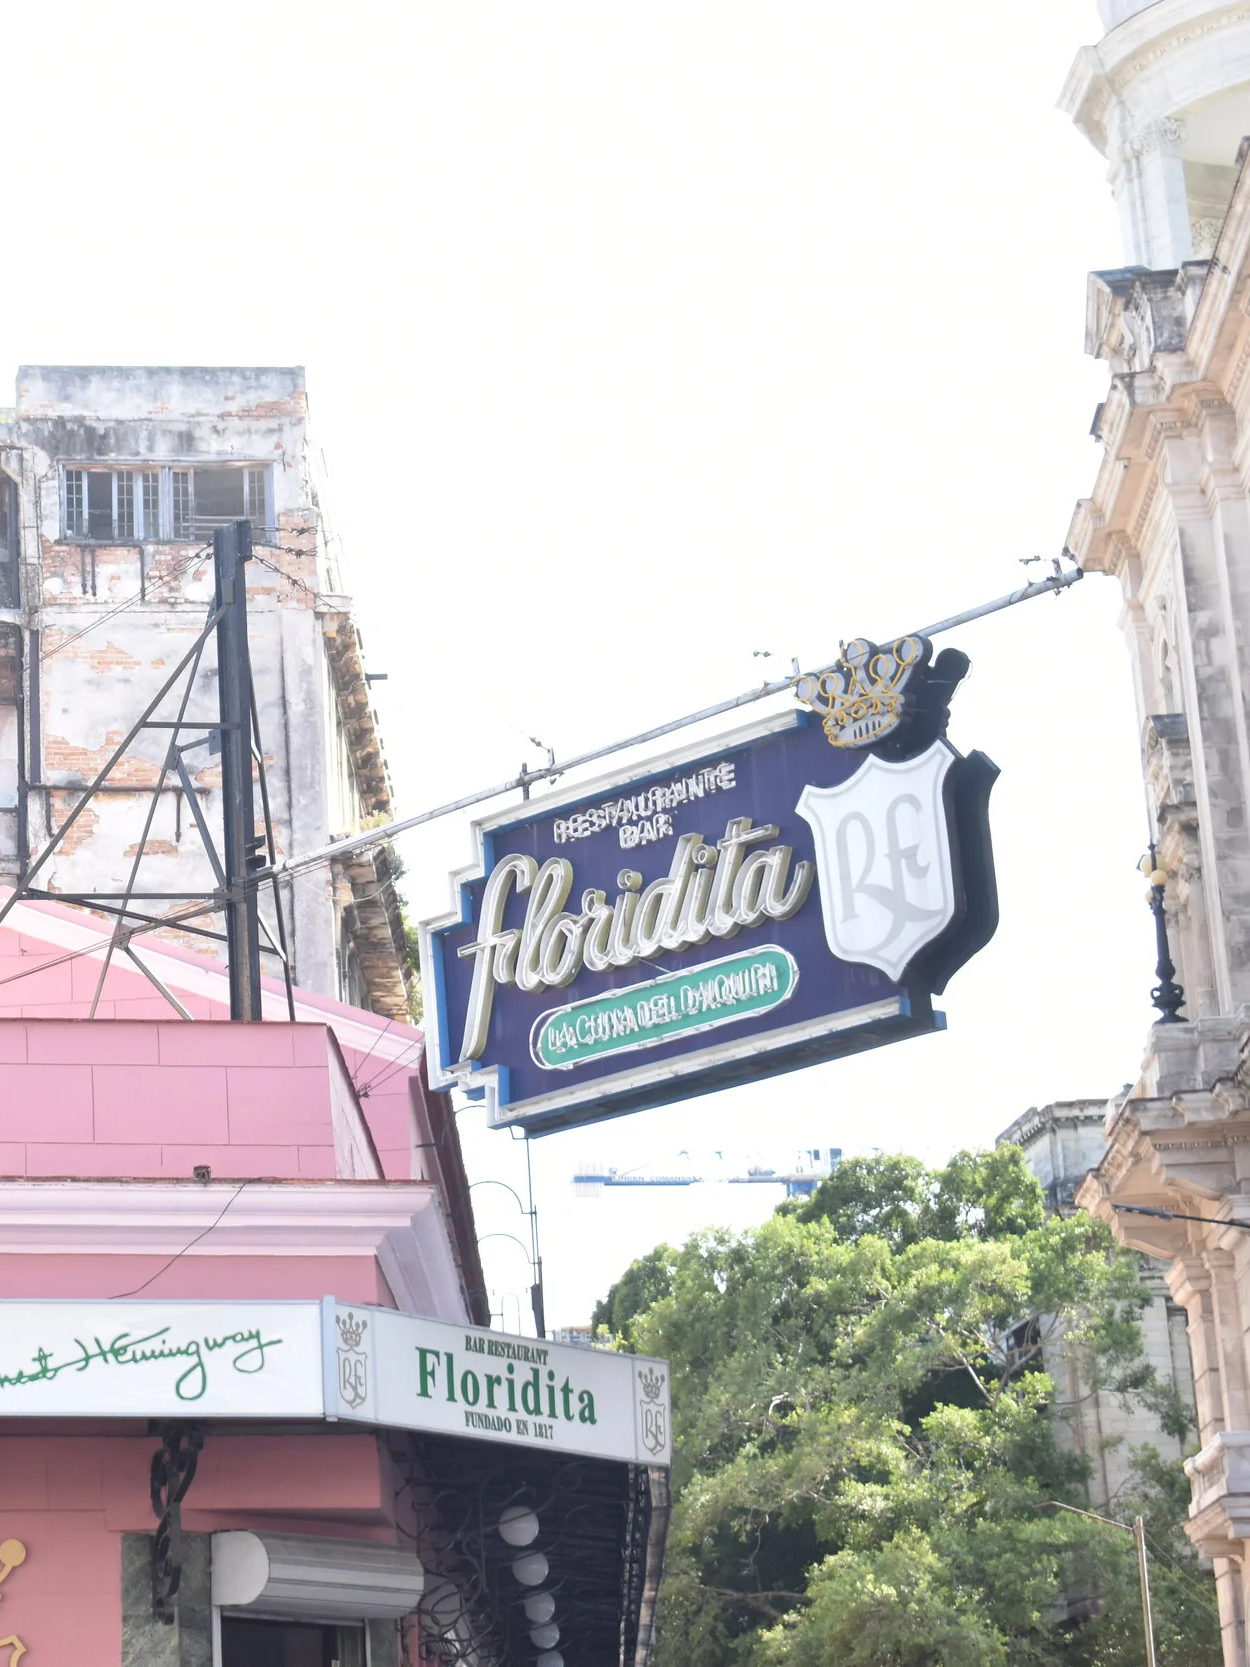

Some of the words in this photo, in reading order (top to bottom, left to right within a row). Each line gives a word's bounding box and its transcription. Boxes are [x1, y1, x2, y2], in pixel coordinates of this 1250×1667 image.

[554, 762, 736, 843] RESTAURANTE
[619, 813, 673, 849] BAR
[73, 1326, 283, 1401] Hemingway
[465, 1335, 485, 1354] BAR
[487, 1338, 548, 1366] RESTAURANT
[415, 1346, 597, 1425] Floridita
[464, 1410, 512, 1433] FUNDADO
[515, 1418, 529, 1436] EN
[533, 1422, 553, 1440] 1817
